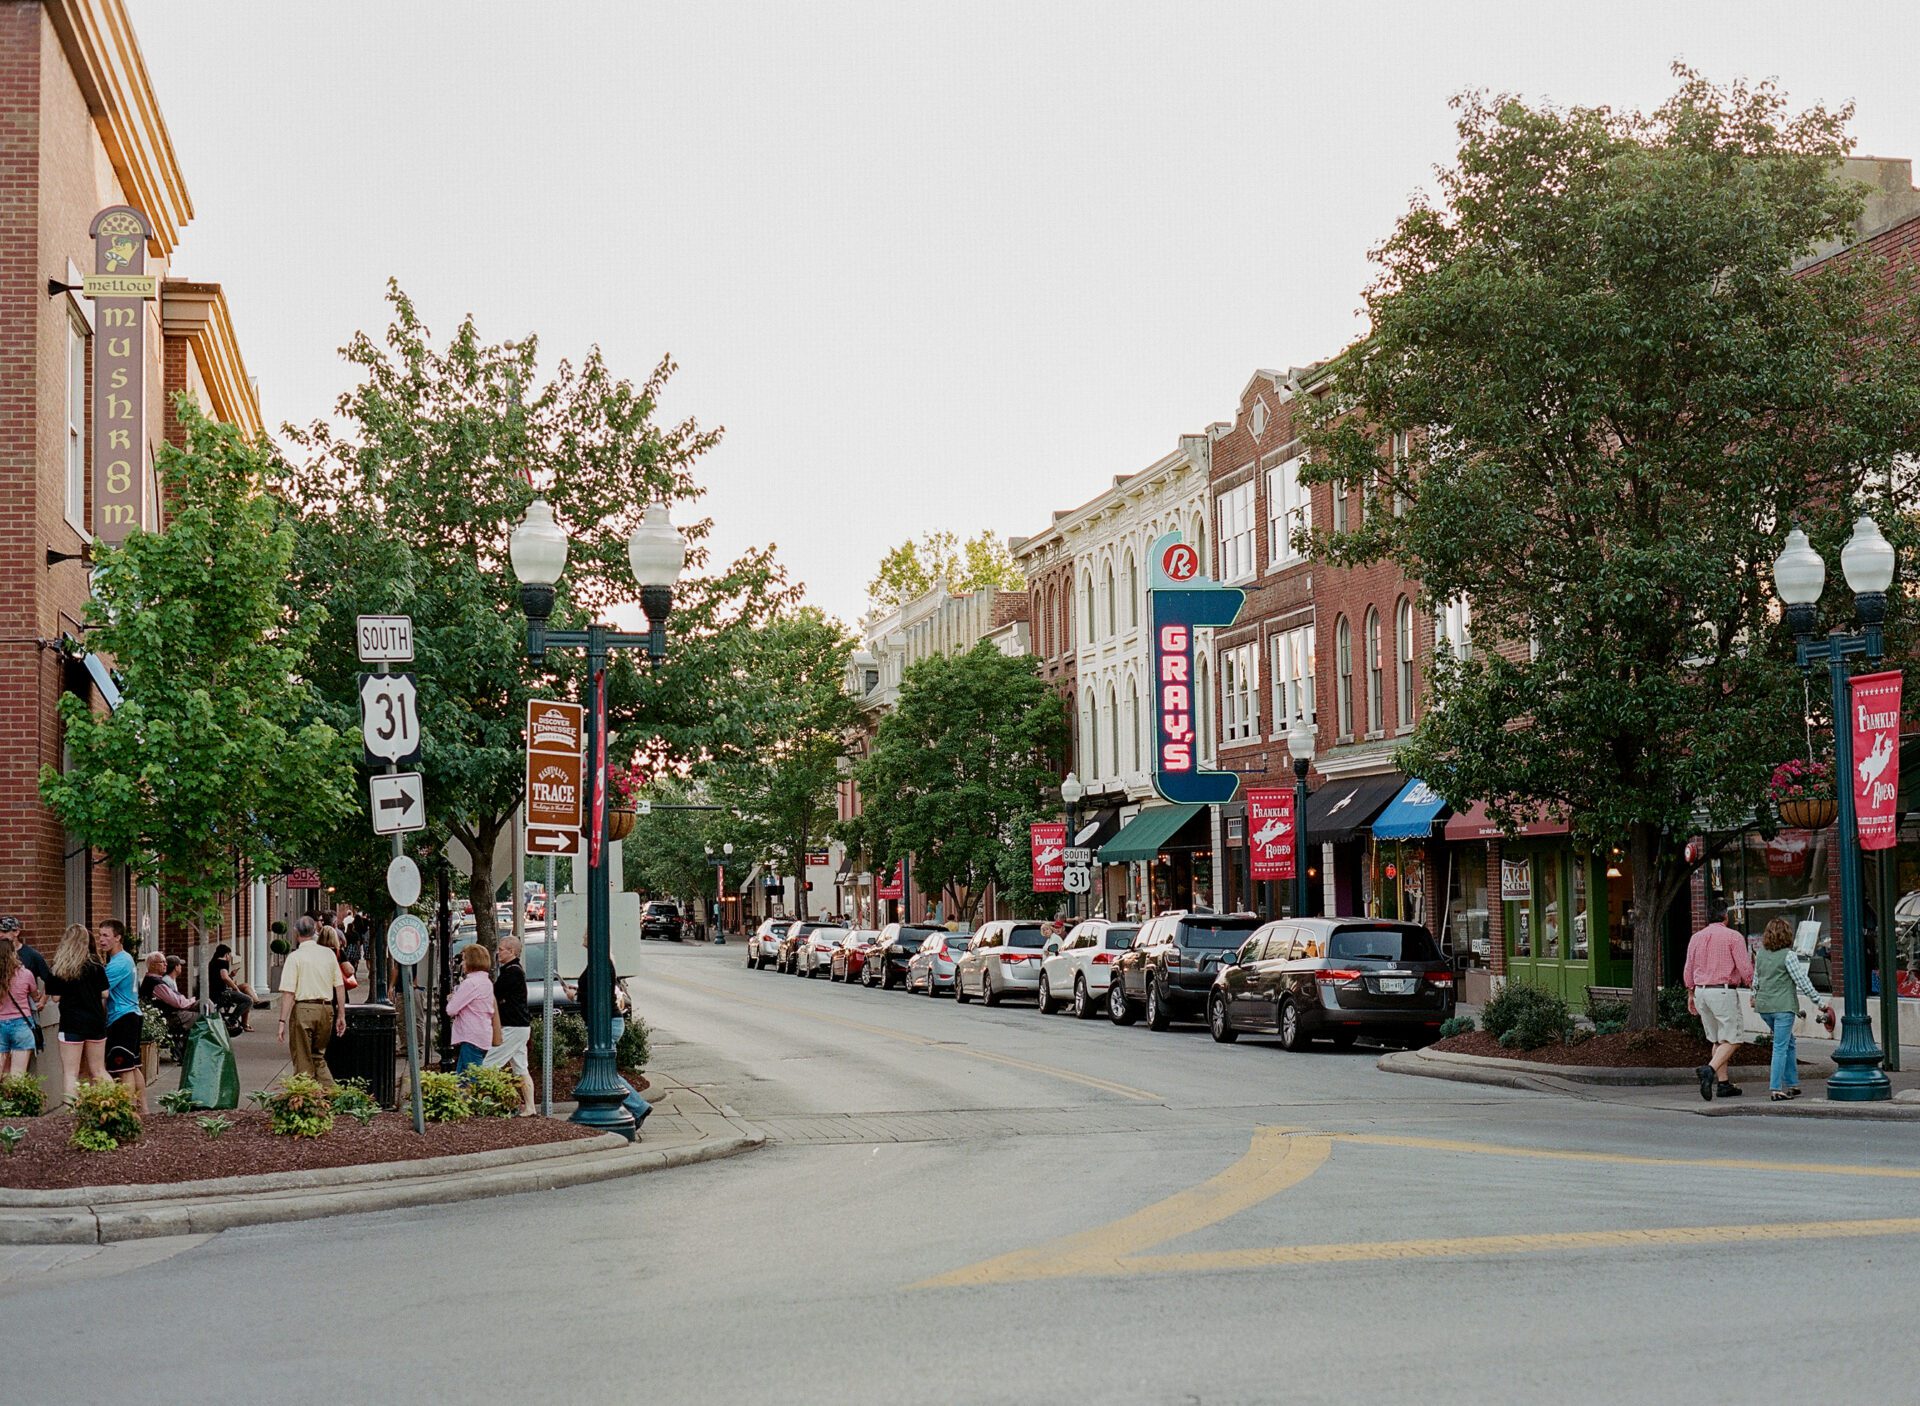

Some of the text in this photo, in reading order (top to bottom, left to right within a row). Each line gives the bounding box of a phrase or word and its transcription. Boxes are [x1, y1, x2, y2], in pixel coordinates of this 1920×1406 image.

[88, 280, 152, 292] mellow
[362, 627, 408, 651] SOUTH
[1161, 626, 1194, 770] GRAY'S
[375, 692, 408, 741] 31
[532, 722, 577, 737] TENNESSEE
[532, 783, 575, 803] TRACE
[1252, 803, 1290, 818] FRANKLIN
[1064, 850, 1089, 859] SOUTH
[1265, 844, 1291, 859] RODEO
[1069, 872, 1085, 887] 31
